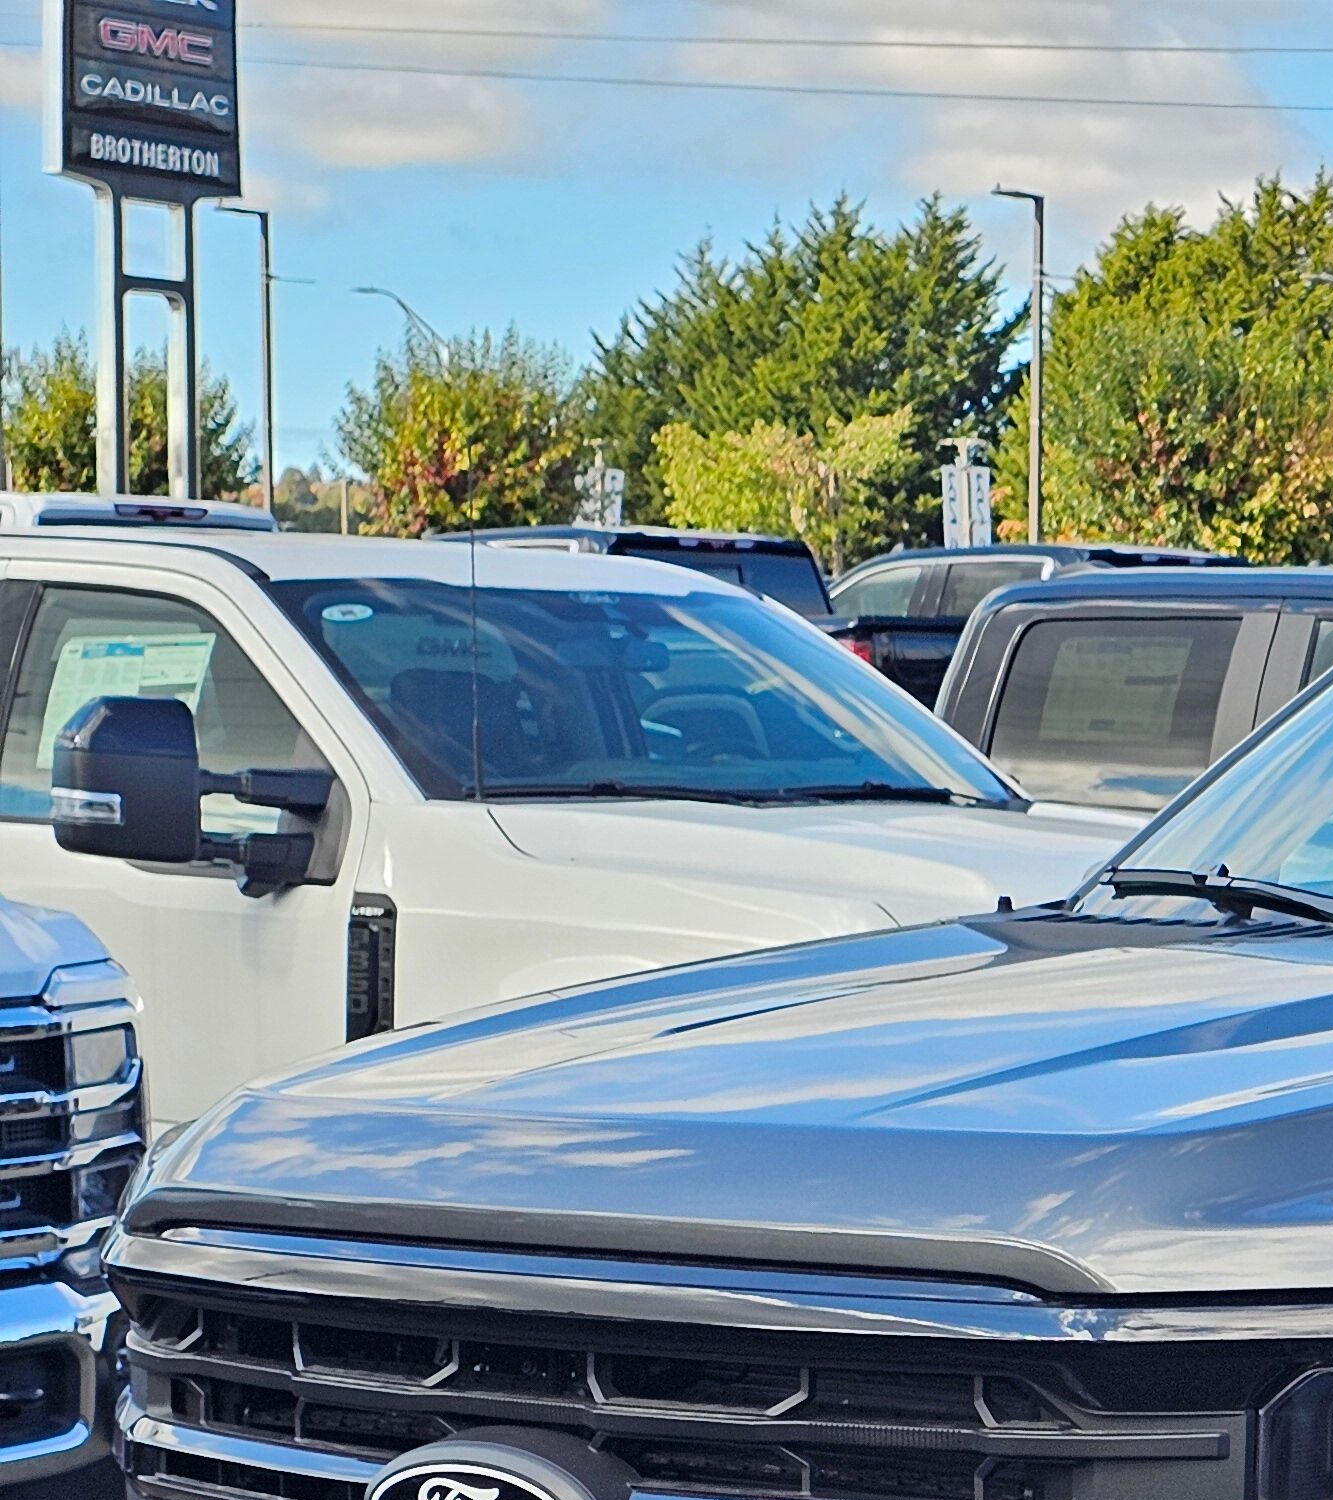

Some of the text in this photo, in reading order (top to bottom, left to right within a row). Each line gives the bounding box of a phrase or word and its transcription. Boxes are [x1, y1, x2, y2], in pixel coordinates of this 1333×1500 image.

[99, 17, 213, 65] GMC
[81, 74, 229, 116] CADILLAC
[90, 133, 220, 178] BROTHERTON
